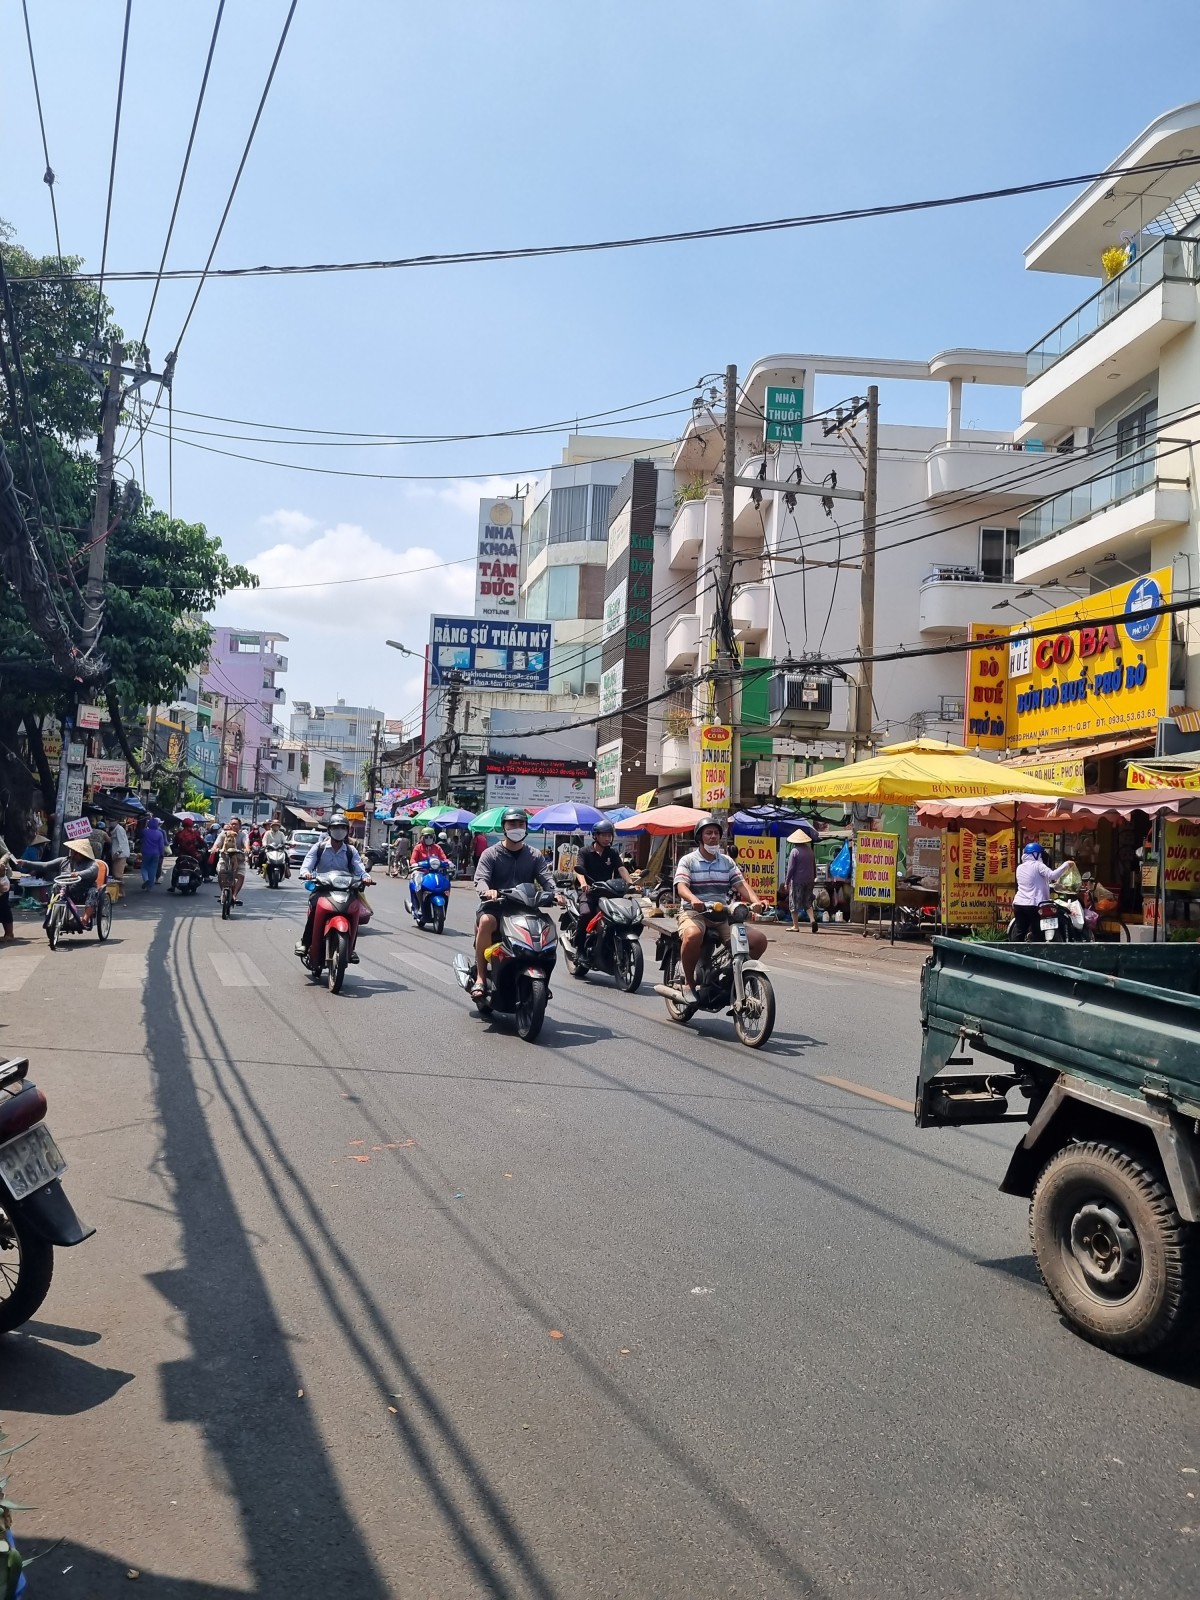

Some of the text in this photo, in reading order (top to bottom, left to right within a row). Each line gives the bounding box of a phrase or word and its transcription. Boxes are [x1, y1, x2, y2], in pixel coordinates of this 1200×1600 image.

[776, 392, 796, 404] NHÀ
[768, 408, 800, 420] THUỐC
[485, 526, 514, 540] NHA
[631, 533, 653, 549] Xinh
[480, 542, 517, 556] KHOA
[480, 559, 518, 578] TÂM
[480, 578, 514, 596] ĐỨC
[434, 624, 548, 648] RĂNG SỨ THẨM MỸ
[1080, 624, 1121, 658] BA
[980, 656, 1000, 677] BÒ
[1016, 684, 1042, 714] BÚN
[1042, 678, 1059, 708] BÒ
[1060, 666, 1088, 704] HUẾ
[1094, 656, 1124, 696] PHỞ
[1126, 654, 1148, 689] BÒ
[973, 680, 1004, 704] HUẾ
[990, 716, 1004, 736] BÒ
[932, 782, 951, 793] BÚN
[954, 784, 967, 794] BÒ
[970, 785, 988, 796] HUẾ
[738, 846, 772, 860] CÔ BA
[752, 862, 760, 874] BÒ
[762, 862, 774, 874] HUẾ
[751, 876, 760, 888] BÒ
[858, 886, 890, 898] NƯỚC MÍA
